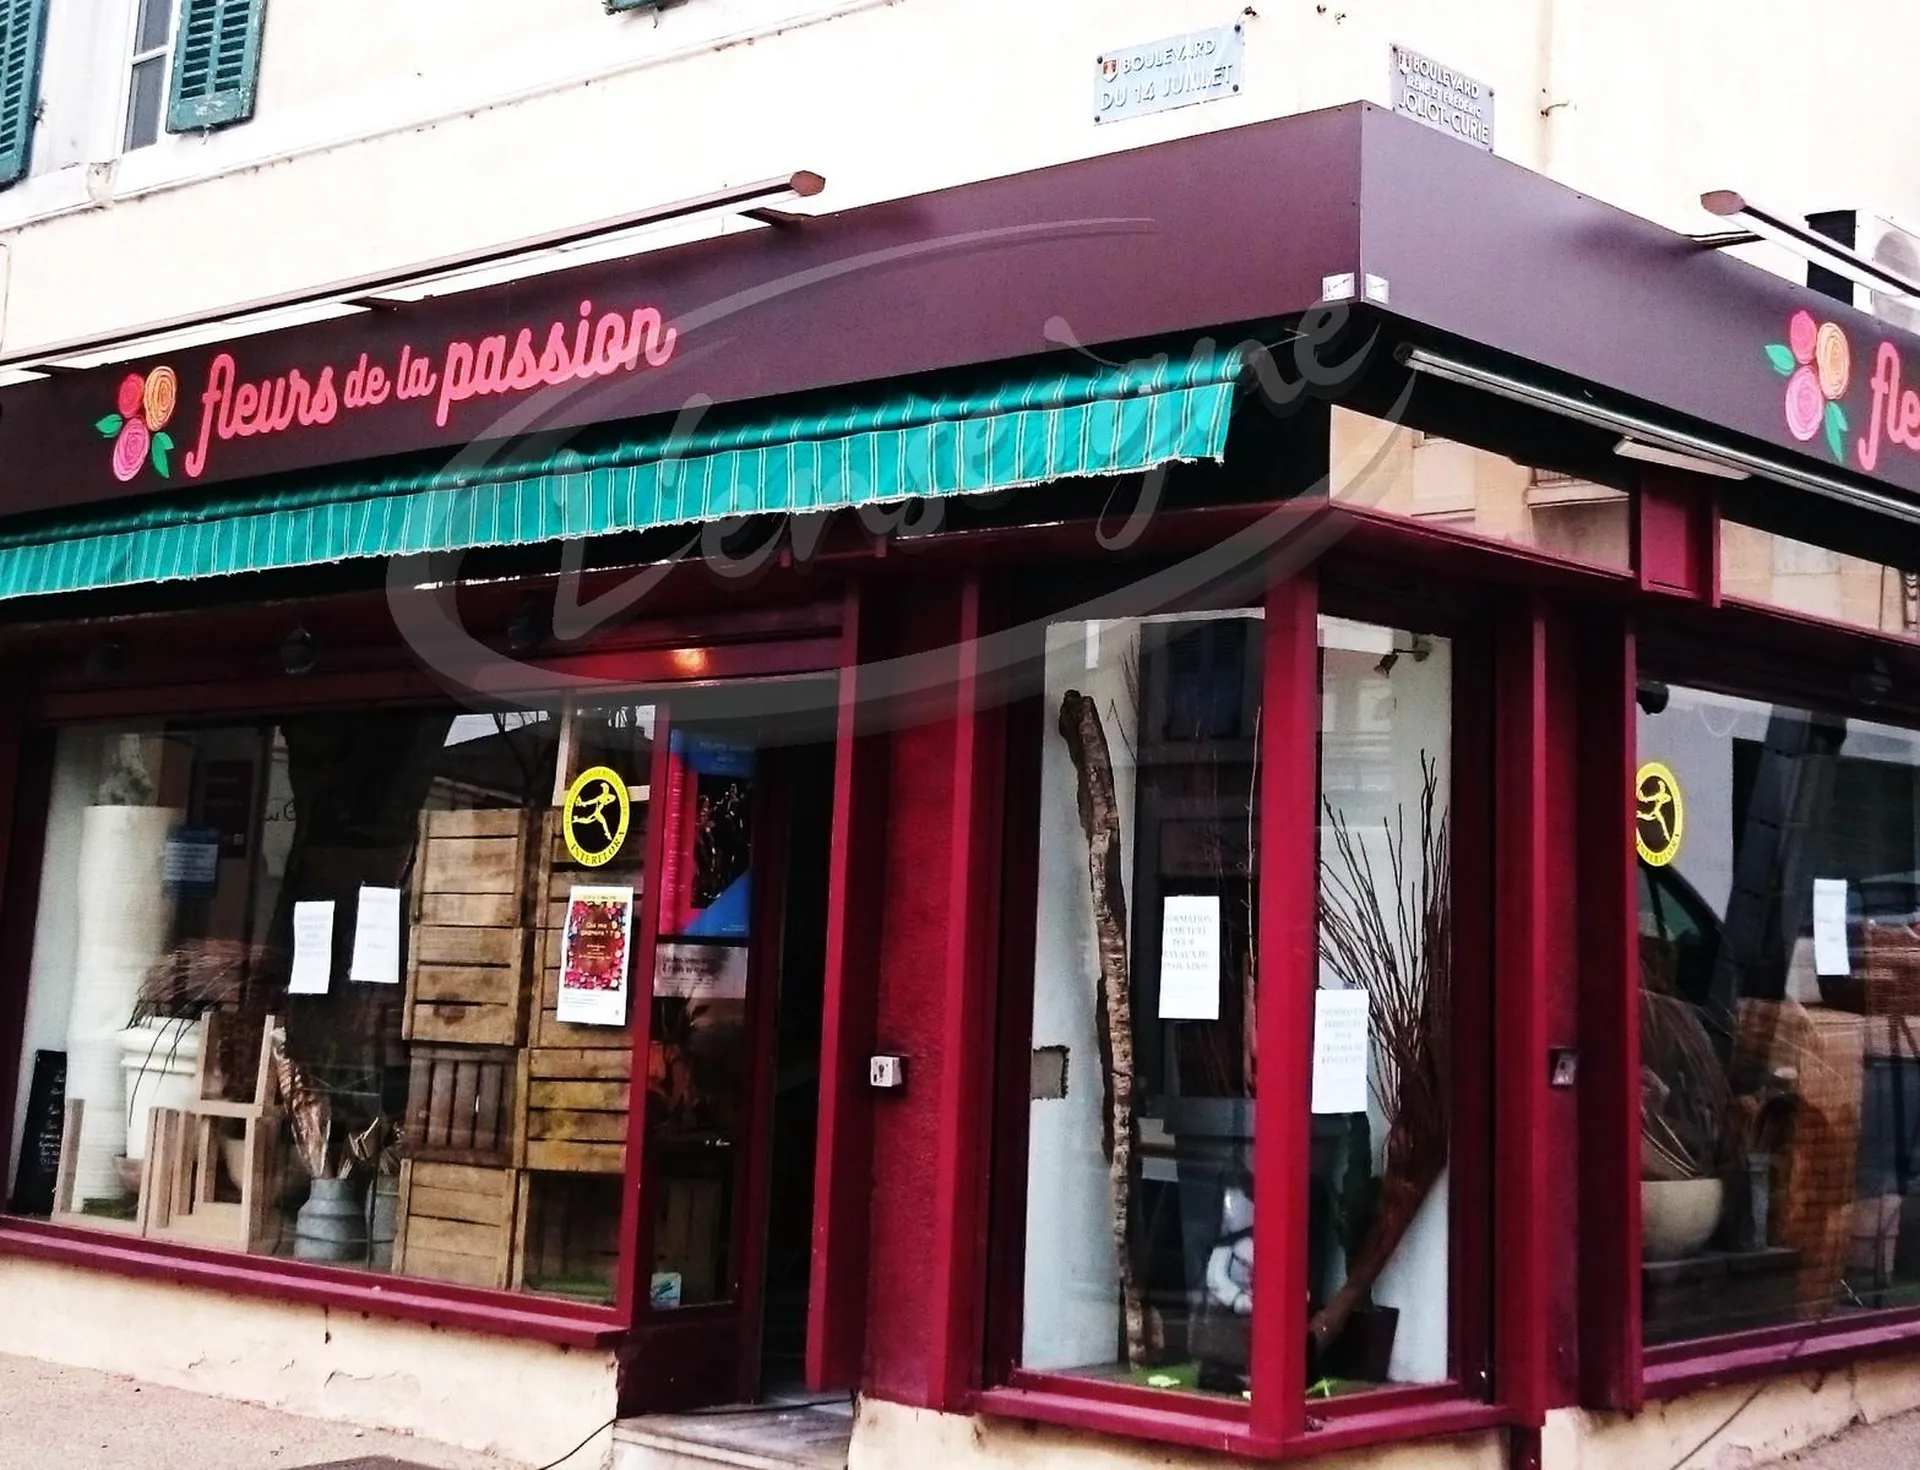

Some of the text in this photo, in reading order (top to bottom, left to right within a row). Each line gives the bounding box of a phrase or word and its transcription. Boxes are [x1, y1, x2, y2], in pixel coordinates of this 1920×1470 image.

[1121, 40, 1216, 74] BOULEVARD
[1412, 56, 1480, 100] BOULEVARD
[1101, 64, 1233, 111] DU 14 JUILLET
[1398, 88, 1489, 146] JOLIOT-CURIE
[184, 299, 677, 478] fleurs de la passion
